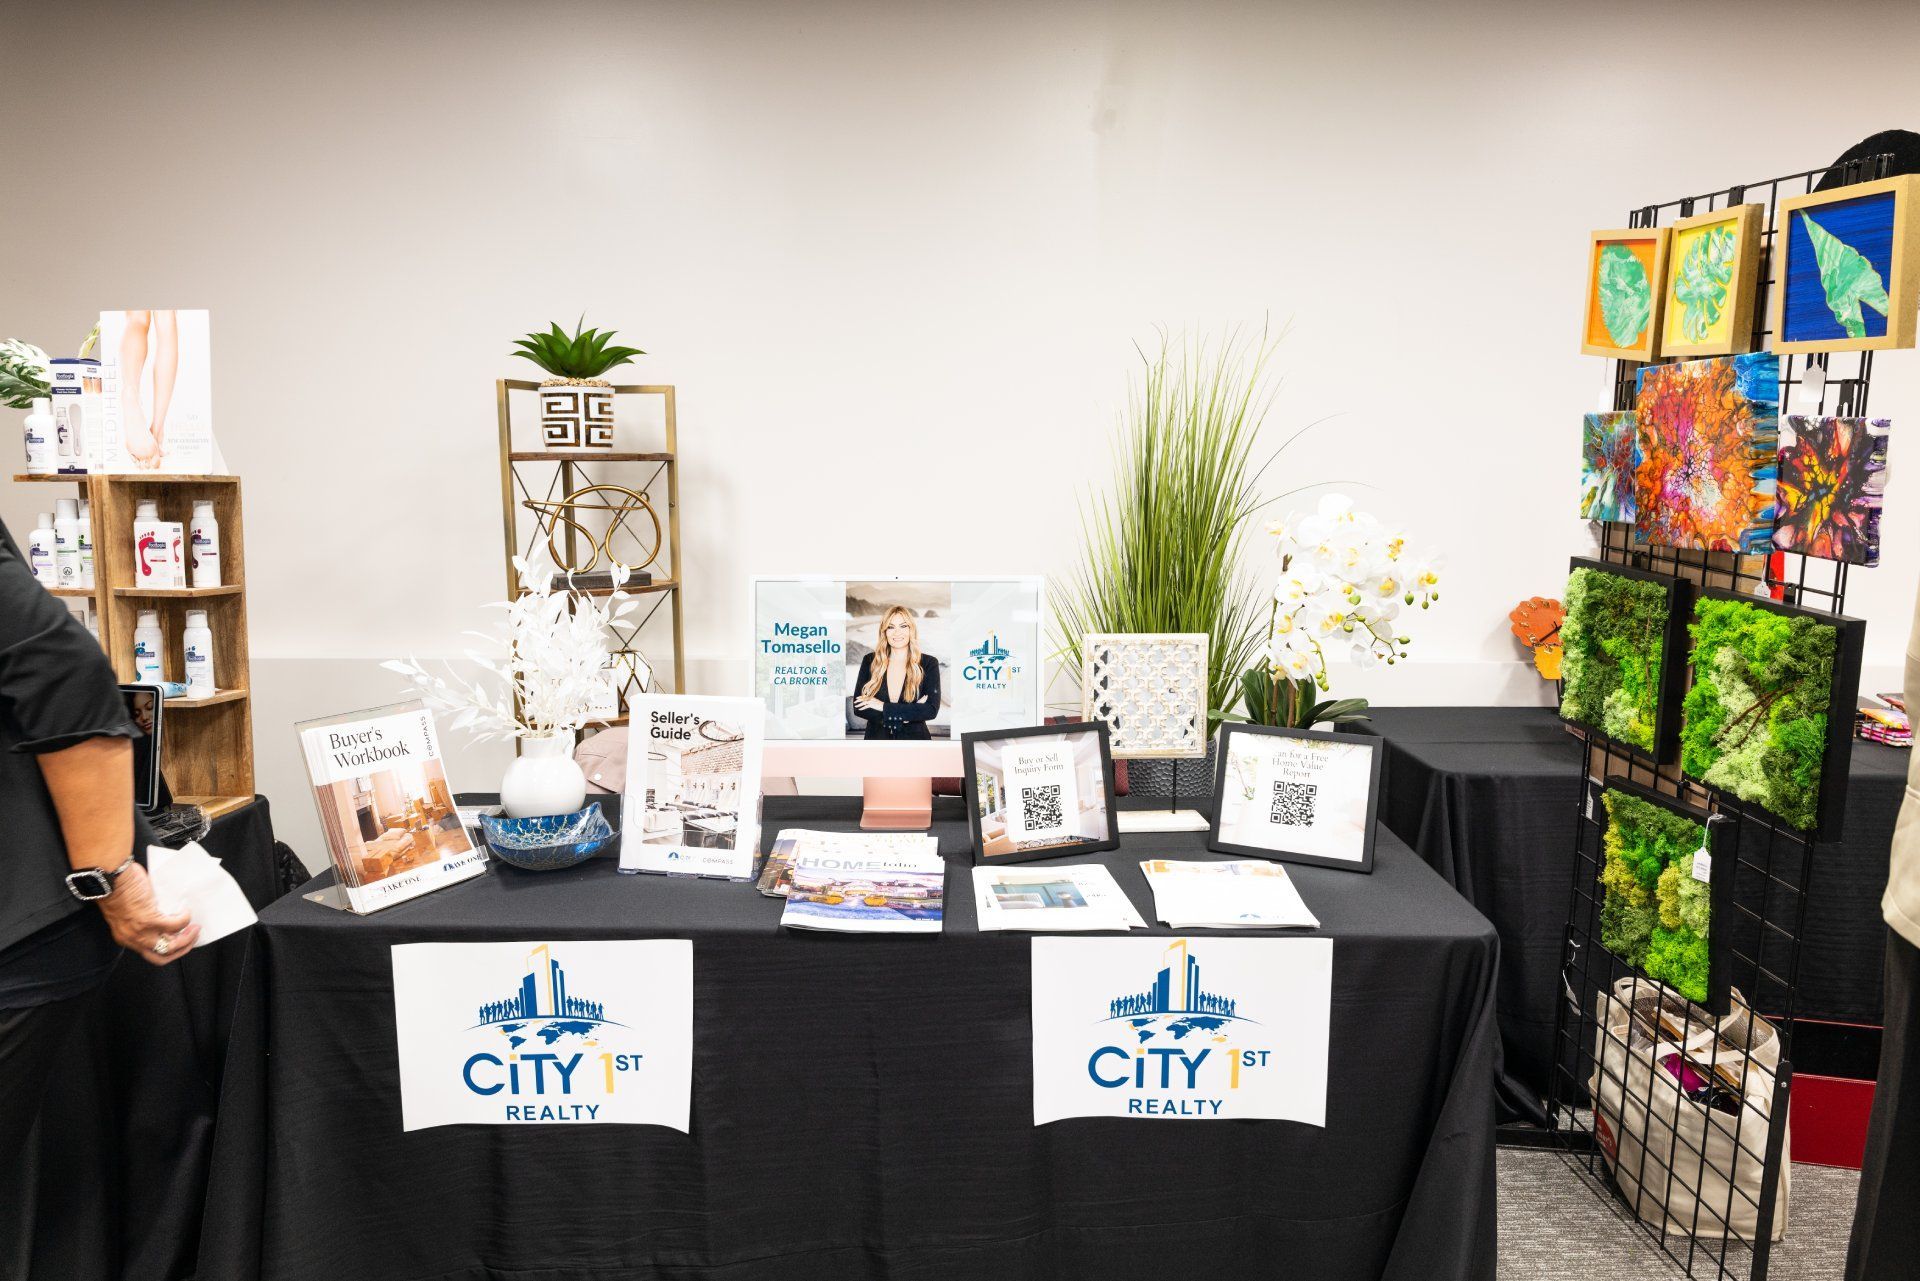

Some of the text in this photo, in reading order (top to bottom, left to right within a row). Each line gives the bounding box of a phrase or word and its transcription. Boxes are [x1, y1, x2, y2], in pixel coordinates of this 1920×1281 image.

[774, 622, 828, 639] Megan
[761, 640, 841, 654] Tomasello
[775, 666, 827, 674] REALTOR &
[773, 677, 828, 685] CA BROKER
[651, 711, 700, 725] Seller's
[329, 726, 383, 750] Buyer's
[650, 727, 691, 740] Guide
[333, 740, 410, 768] Workbook
[506, 1104, 600, 1121] REALTY
[1128, 1098, 1223, 1115] REALTY
